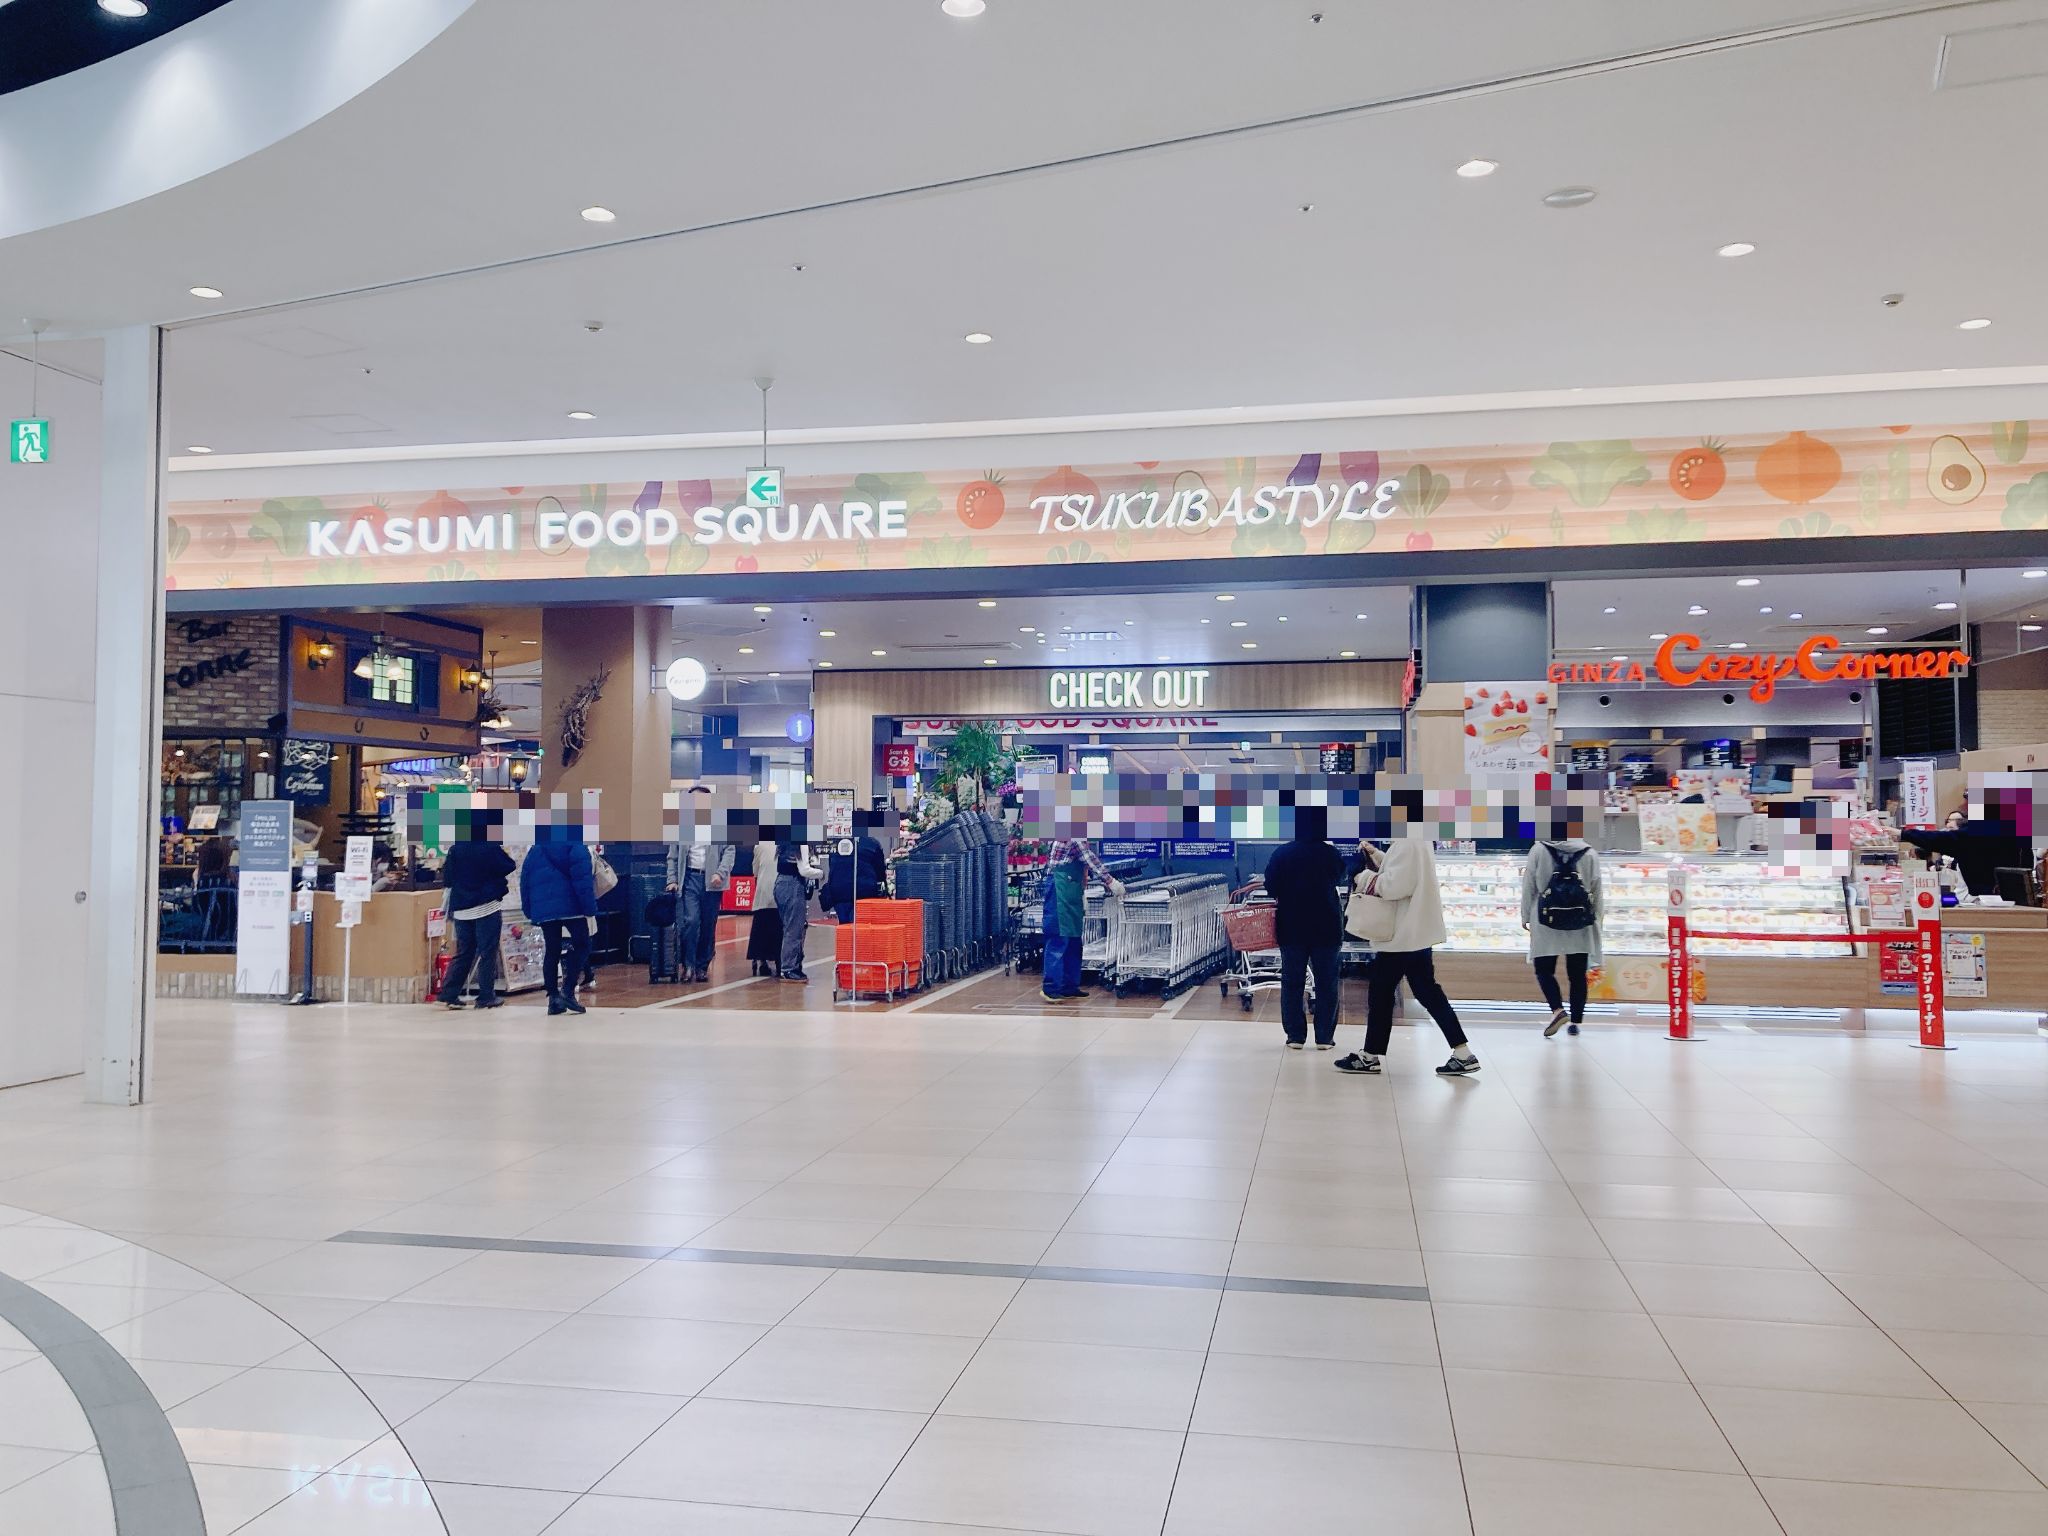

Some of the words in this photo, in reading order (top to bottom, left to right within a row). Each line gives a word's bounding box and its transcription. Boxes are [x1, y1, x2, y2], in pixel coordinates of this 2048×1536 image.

[308, 513, 513, 556] KASUMI
[539, 506, 678, 549] FOOD
[693, 500, 909, 546] SQUARE
[1547, 662, 1646, 684] GINZA
[1655, 633, 1799, 704] Cozy
[1796, 635, 1972, 683] Corner
[1050, 671, 1144, 708] CHECK
[1152, 670, 1210, 707] OUT
[735, 897, 751, 907] Lite
[1915, 878, 1936, 888] 出口
